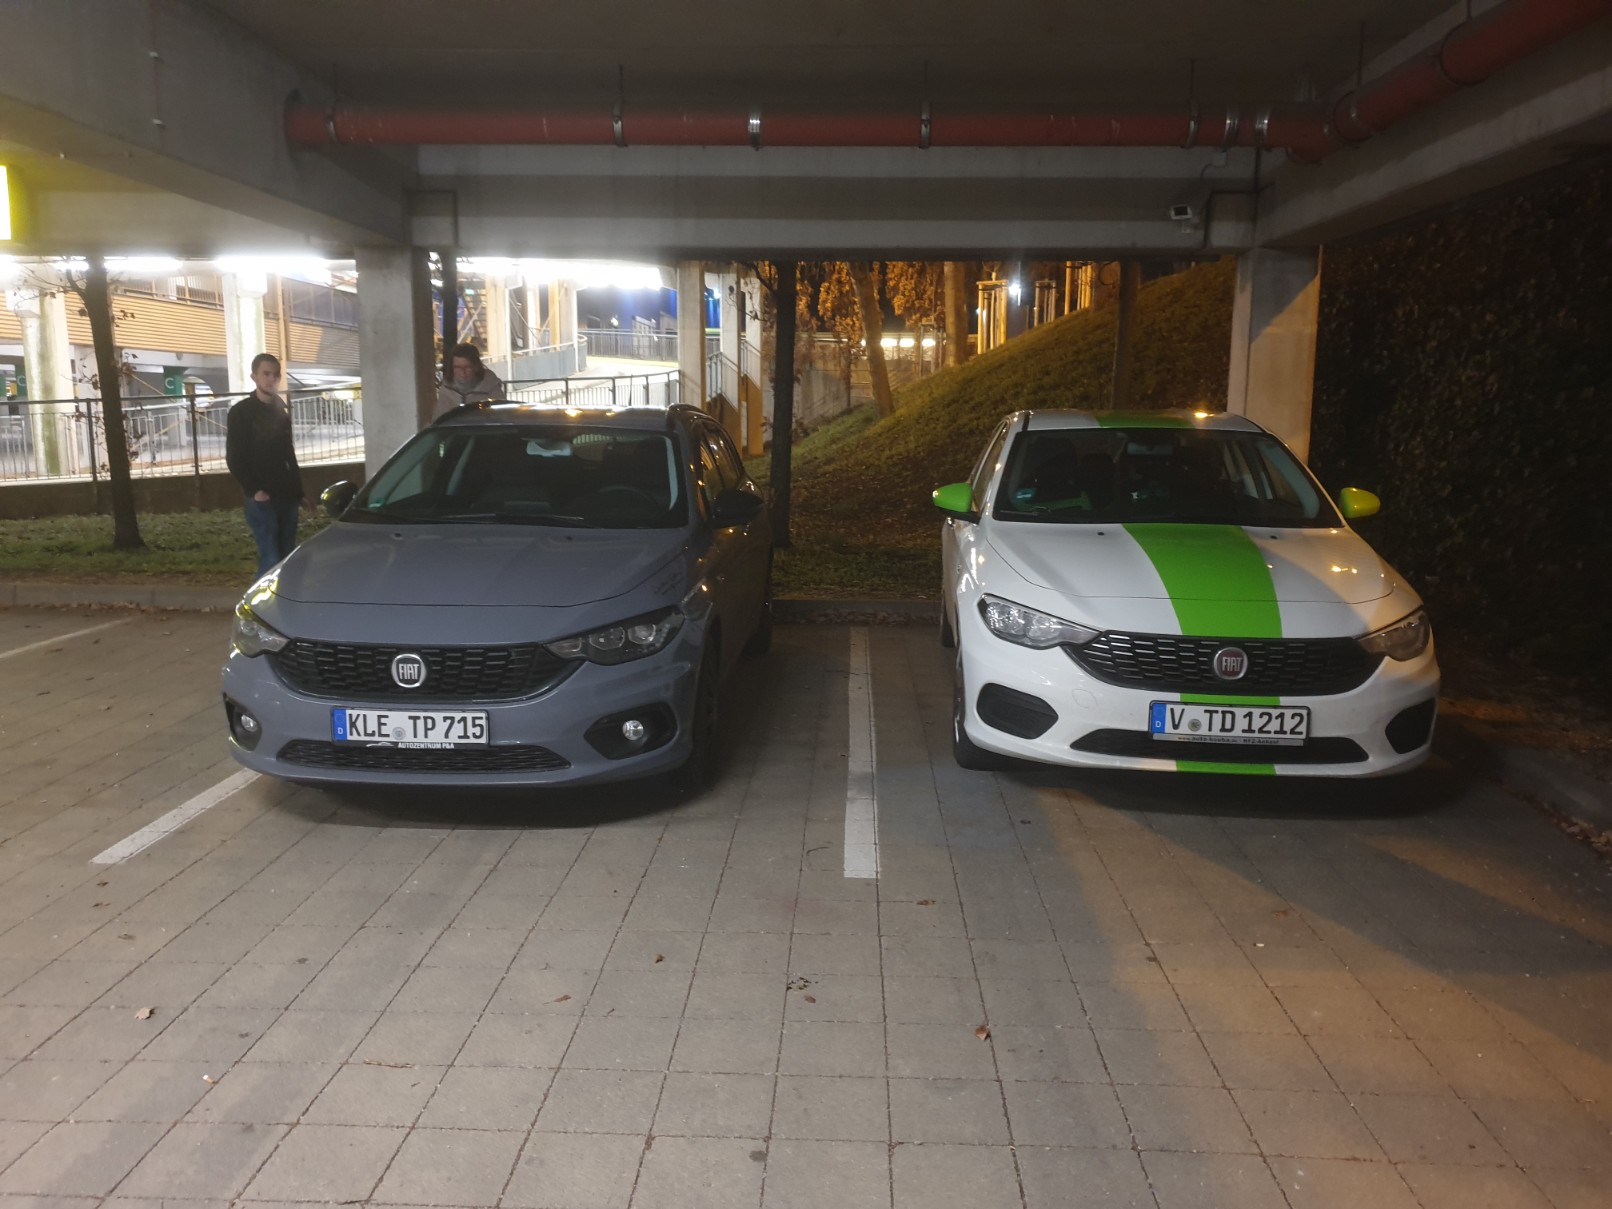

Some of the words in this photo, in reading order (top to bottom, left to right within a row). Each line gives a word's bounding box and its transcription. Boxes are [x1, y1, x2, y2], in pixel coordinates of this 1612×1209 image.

[165, 377, 175, 389] C
[398, 663, 419, 680] FIAT
[1222, 656, 1243, 672] FIAT
[348, 713, 391, 738] KLE
[408, 715, 436, 739] TP
[442, 716, 485, 740] 715
[1169, 707, 1185, 731] V
[1203, 709, 1236, 733] TD
[1241, 711, 1305, 736] 1212
[337, 727, 344, 735] D
